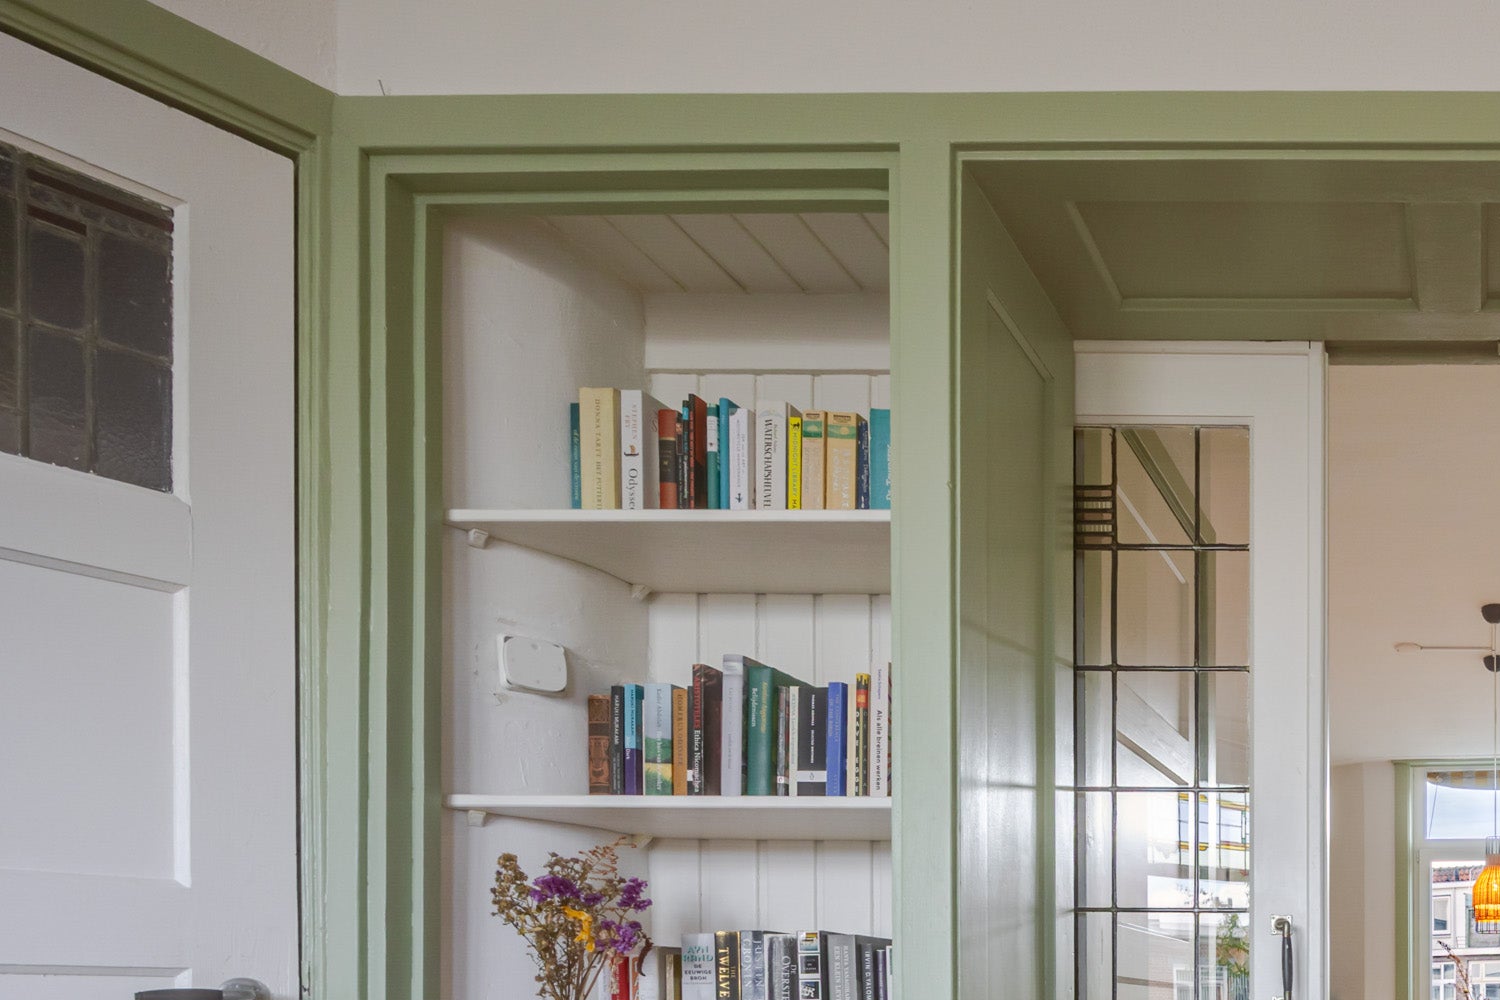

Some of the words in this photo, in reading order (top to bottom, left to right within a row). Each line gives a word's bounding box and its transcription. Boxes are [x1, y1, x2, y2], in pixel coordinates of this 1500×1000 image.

[763, 419, 774, 507] WATERSCHAPSHEUVEL
[875, 710, 883, 721] Als
[693, 730, 701, 751] Ethica
[875, 723, 883, 735] alle
[875, 738, 883, 763] breinen
[875, 765, 883, 790] werken
[718, 947, 731, 998] TWELVE
[743, 939, 752, 987] CRONIN
